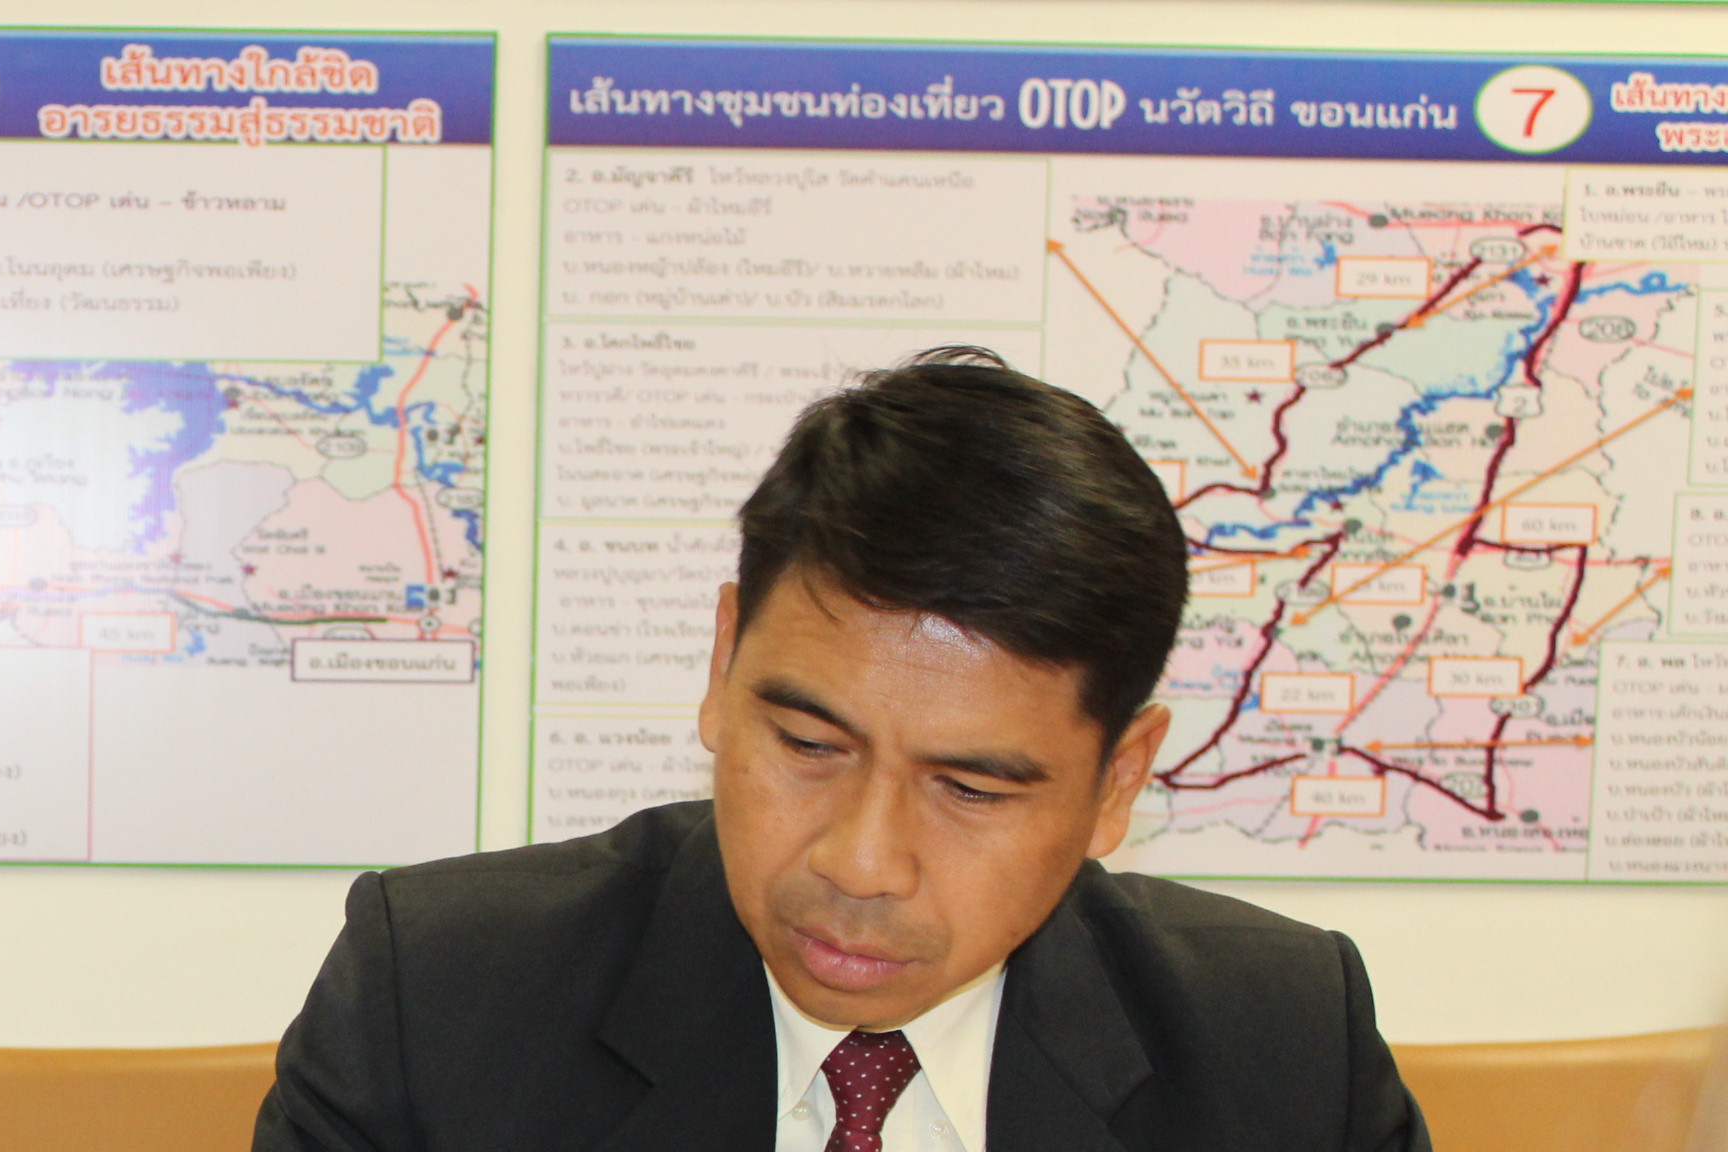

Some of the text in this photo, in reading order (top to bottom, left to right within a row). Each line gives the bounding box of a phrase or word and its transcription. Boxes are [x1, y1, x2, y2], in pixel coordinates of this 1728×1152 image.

[101, 45, 378, 95] เส้นทางใกล้ชิด
[569, 77, 1458, 130] เส้นทางชุมชนท่องเที่ยว OTOP นวัตวิถี ขอนแก่น
[1511, 87, 1556, 138] 7
[1611, 73, 1728, 113] เส้นทาง
[39, 99, 441, 147] อารยธรรมสู่ธรรมชาติ
[1656, 122, 1728, 152] พระ
[15, 191, 102, 210] /OTOP
[109, 190, 151, 211] เด่น
[562, 197, 624, 214] OTOP
[101, 258, 298, 285] (เศรษฐกิจพอเพียง)
